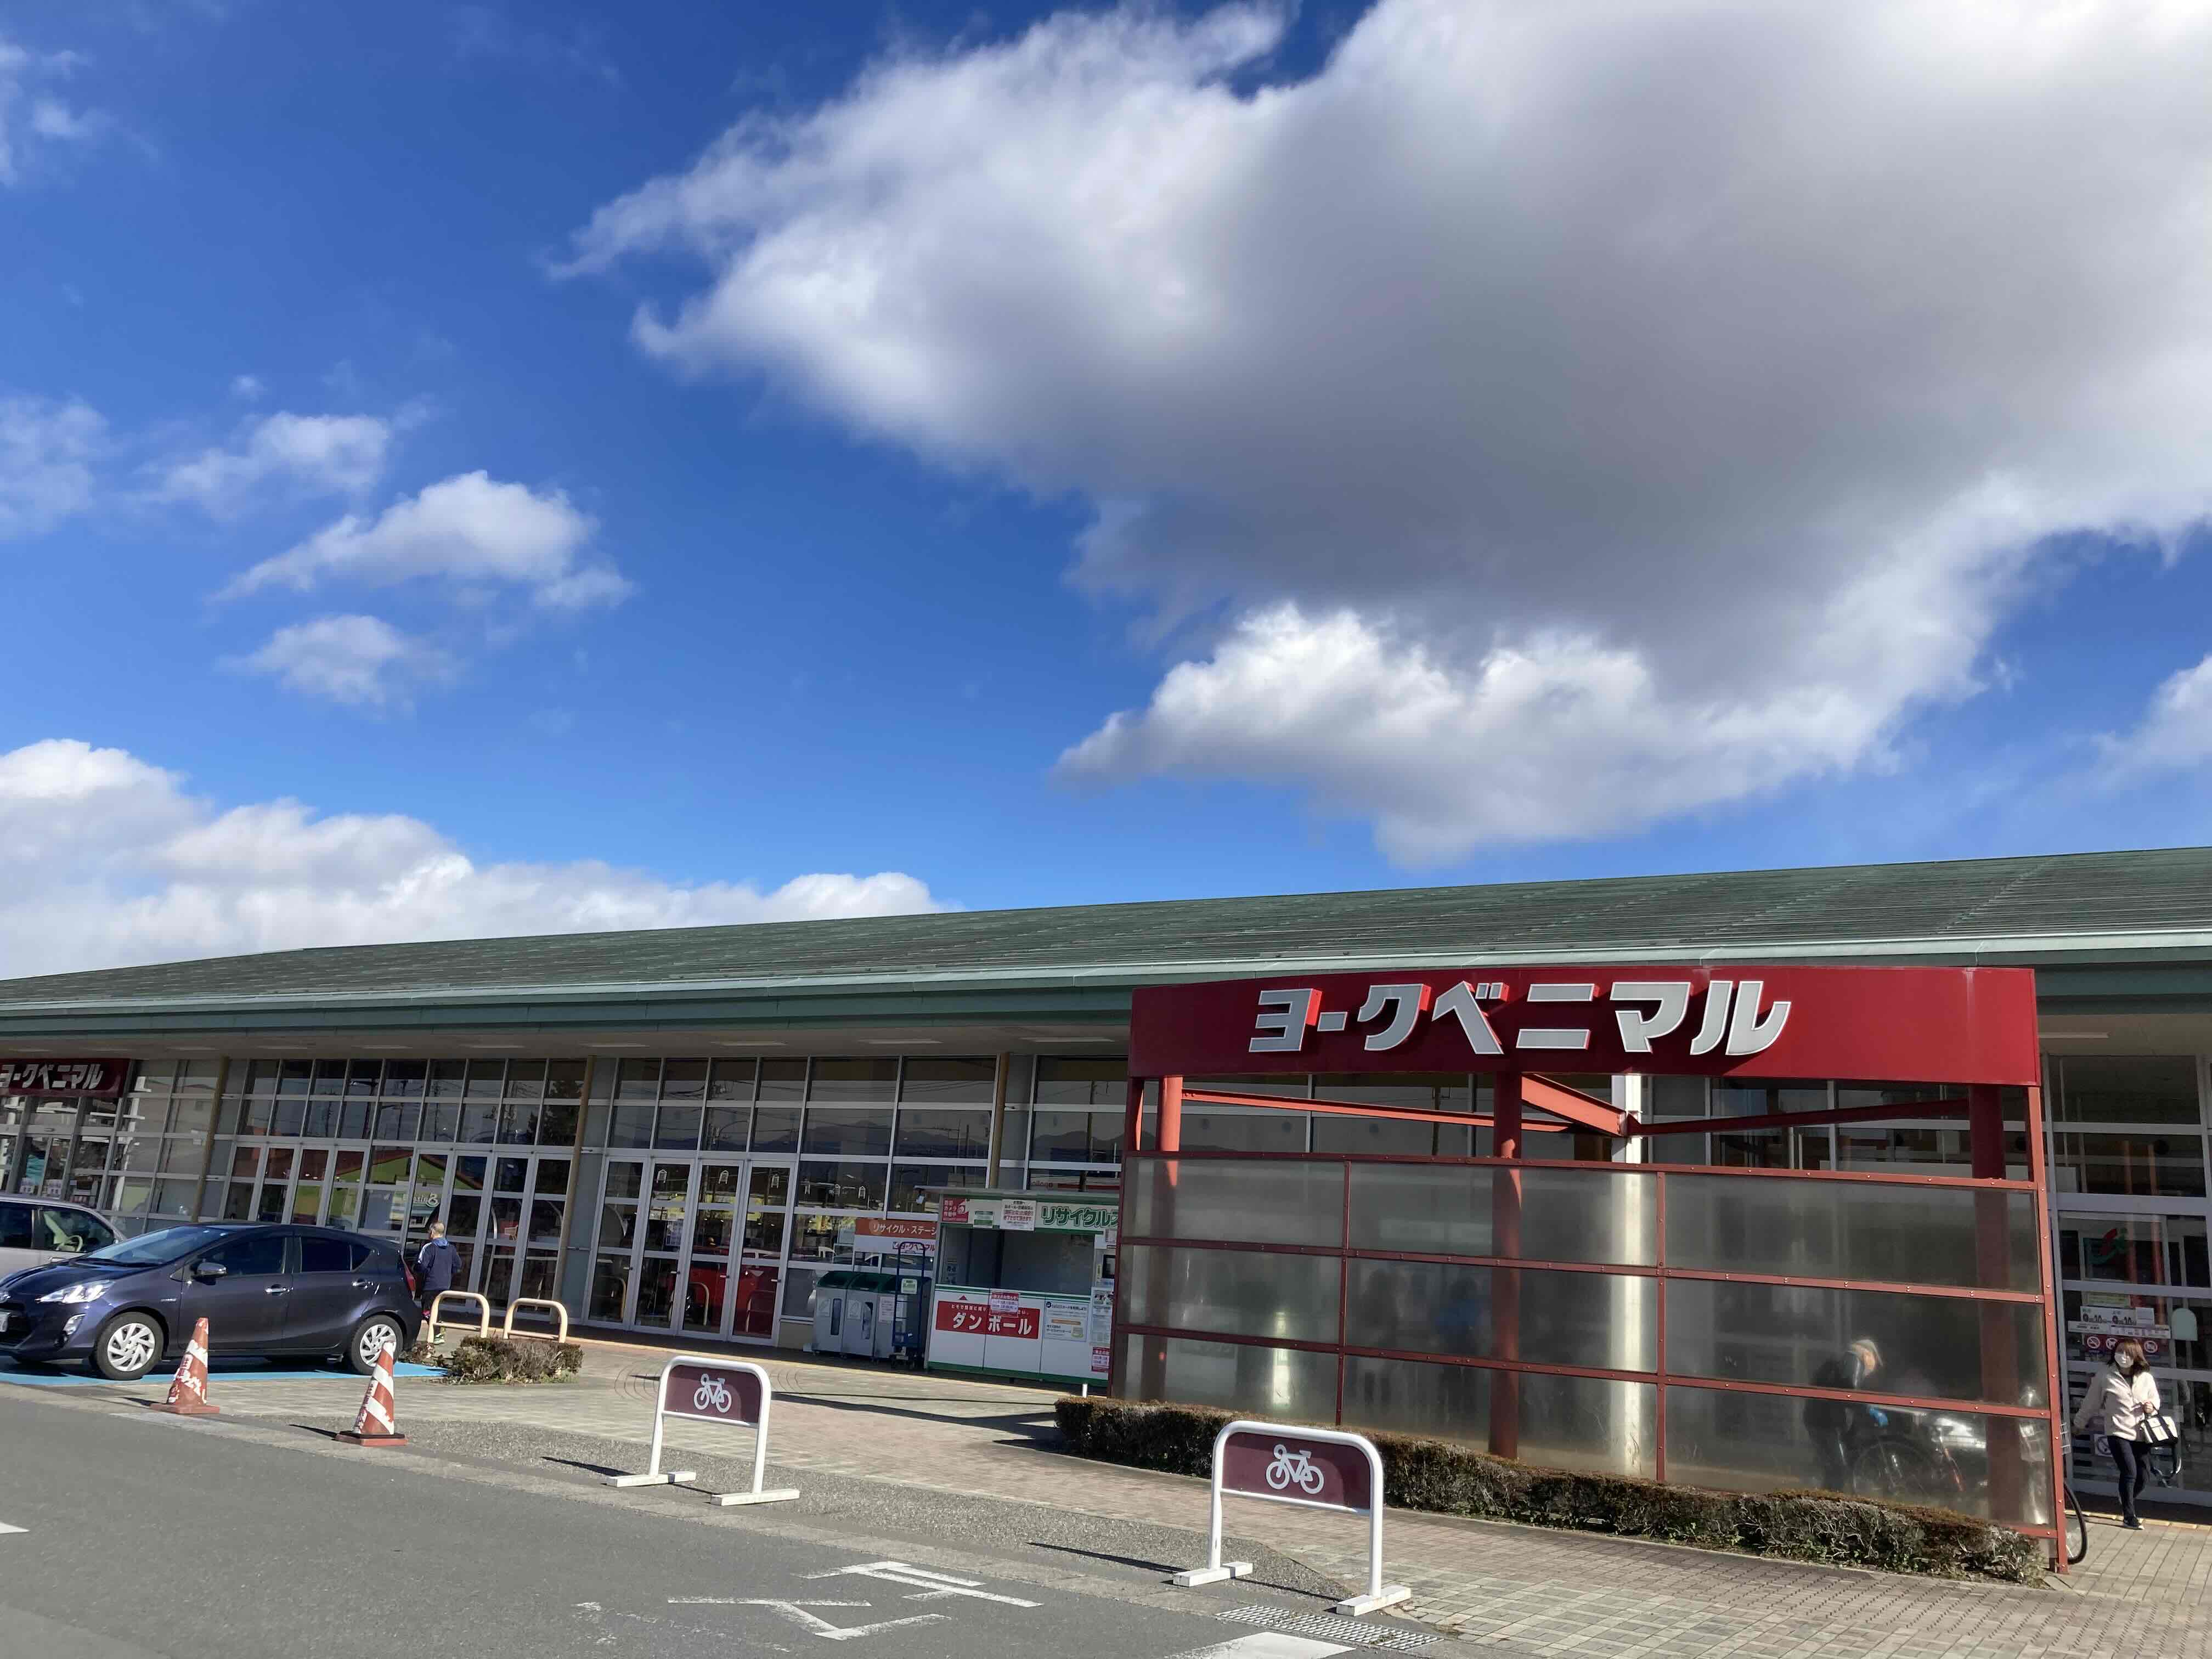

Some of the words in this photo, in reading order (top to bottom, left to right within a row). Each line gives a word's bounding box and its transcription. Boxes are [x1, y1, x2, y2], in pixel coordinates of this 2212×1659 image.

[1249, 980, 1792, 1056] ヨークベニマル
[0, 1063, 104, 1090] ヨークベニマル
[953, 1312, 1032, 1335] ダンボール
